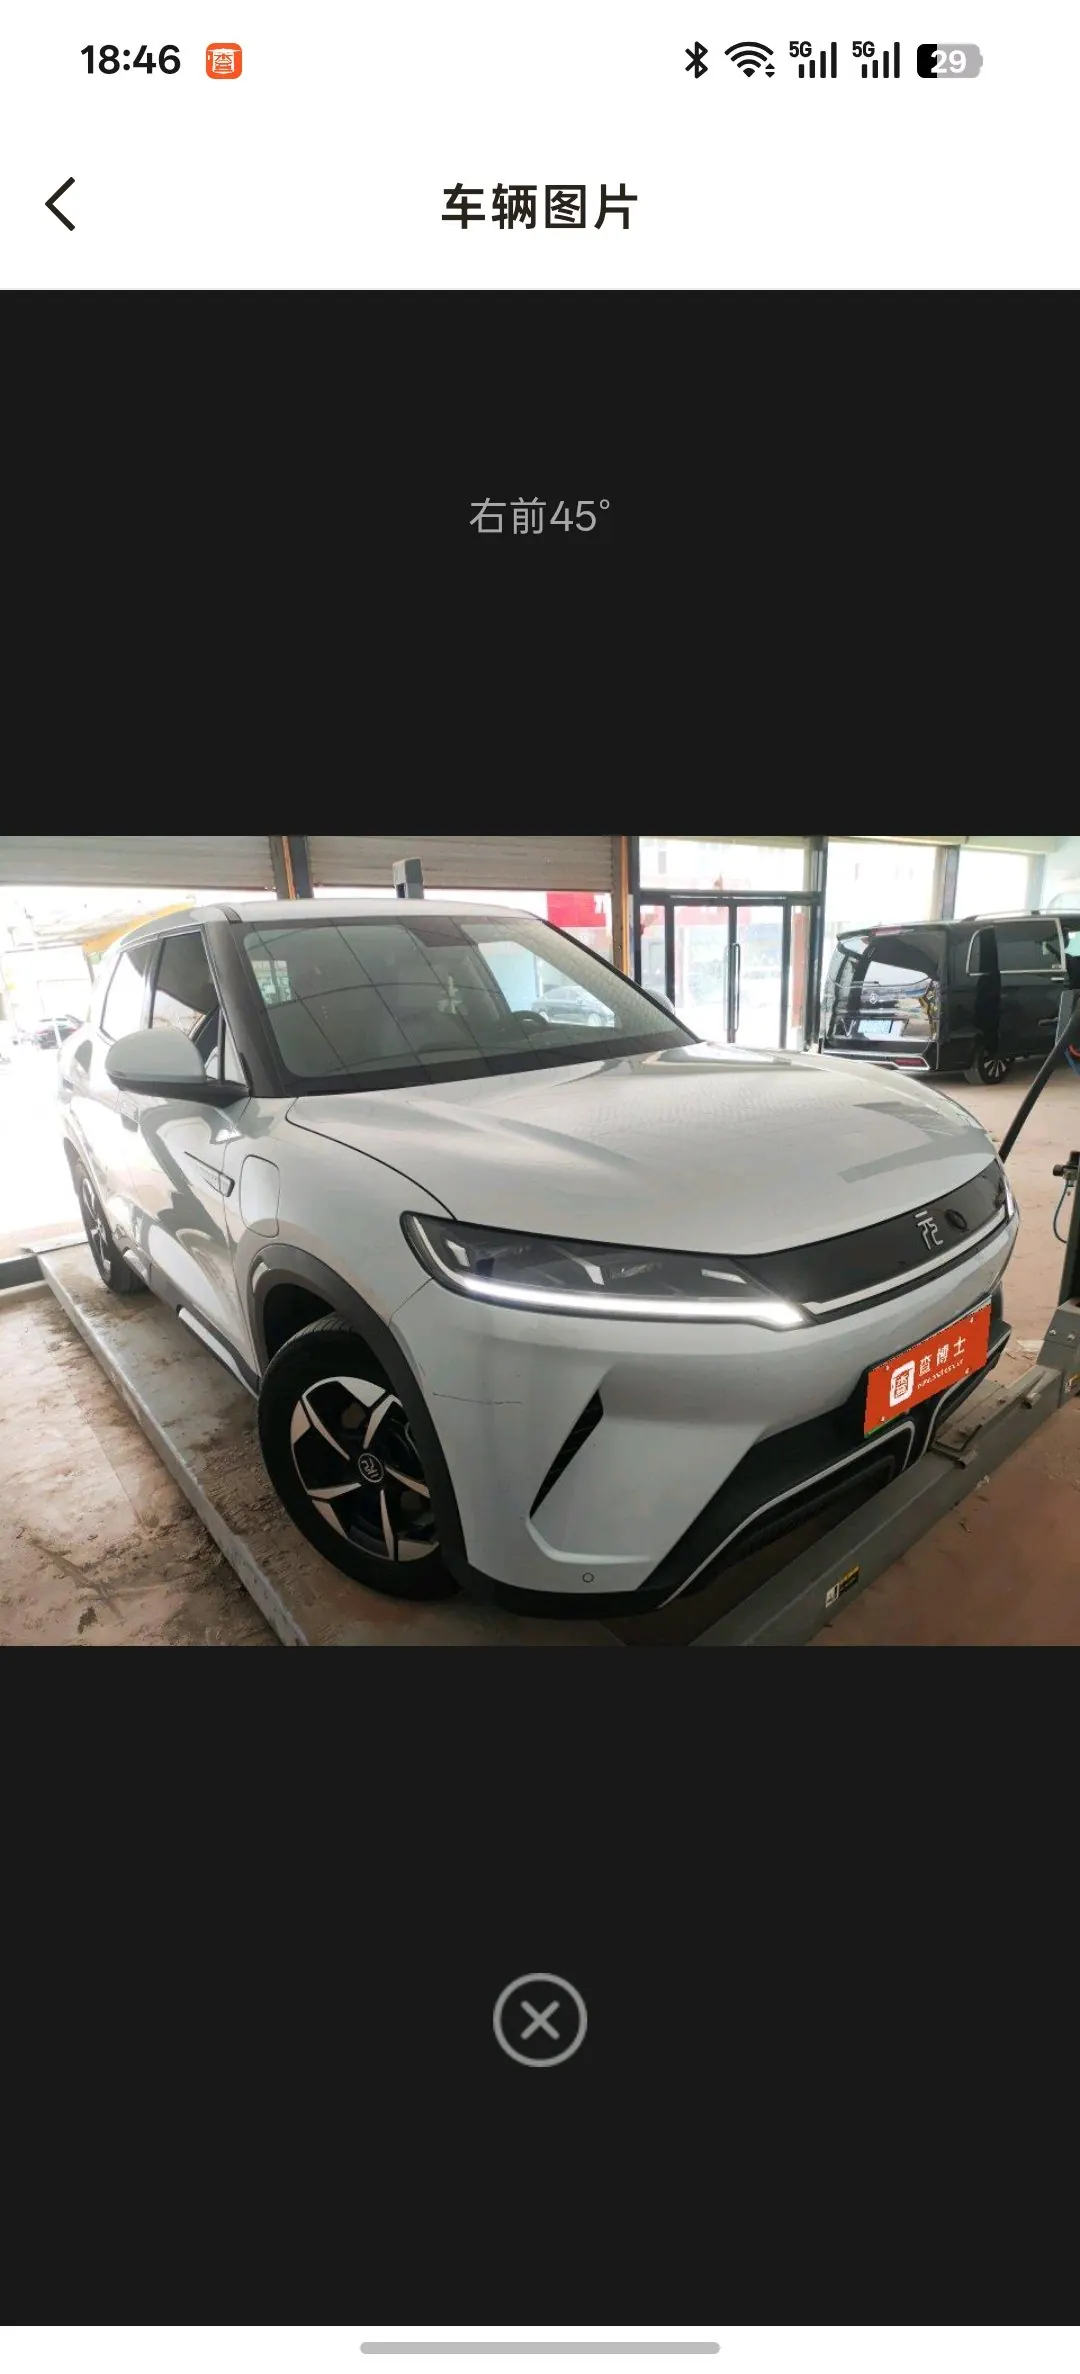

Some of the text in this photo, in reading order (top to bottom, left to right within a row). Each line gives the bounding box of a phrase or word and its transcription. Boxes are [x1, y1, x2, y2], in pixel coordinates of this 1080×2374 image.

[81, 45, 180, 74] 18:46
[790, 41, 812, 57] 5G
[853, 41, 875, 57] 5G
[931, 50, 967, 73] 29
[442, 183, 637, 229] 车辆图片
[470, 497, 609, 534] 右前45°
